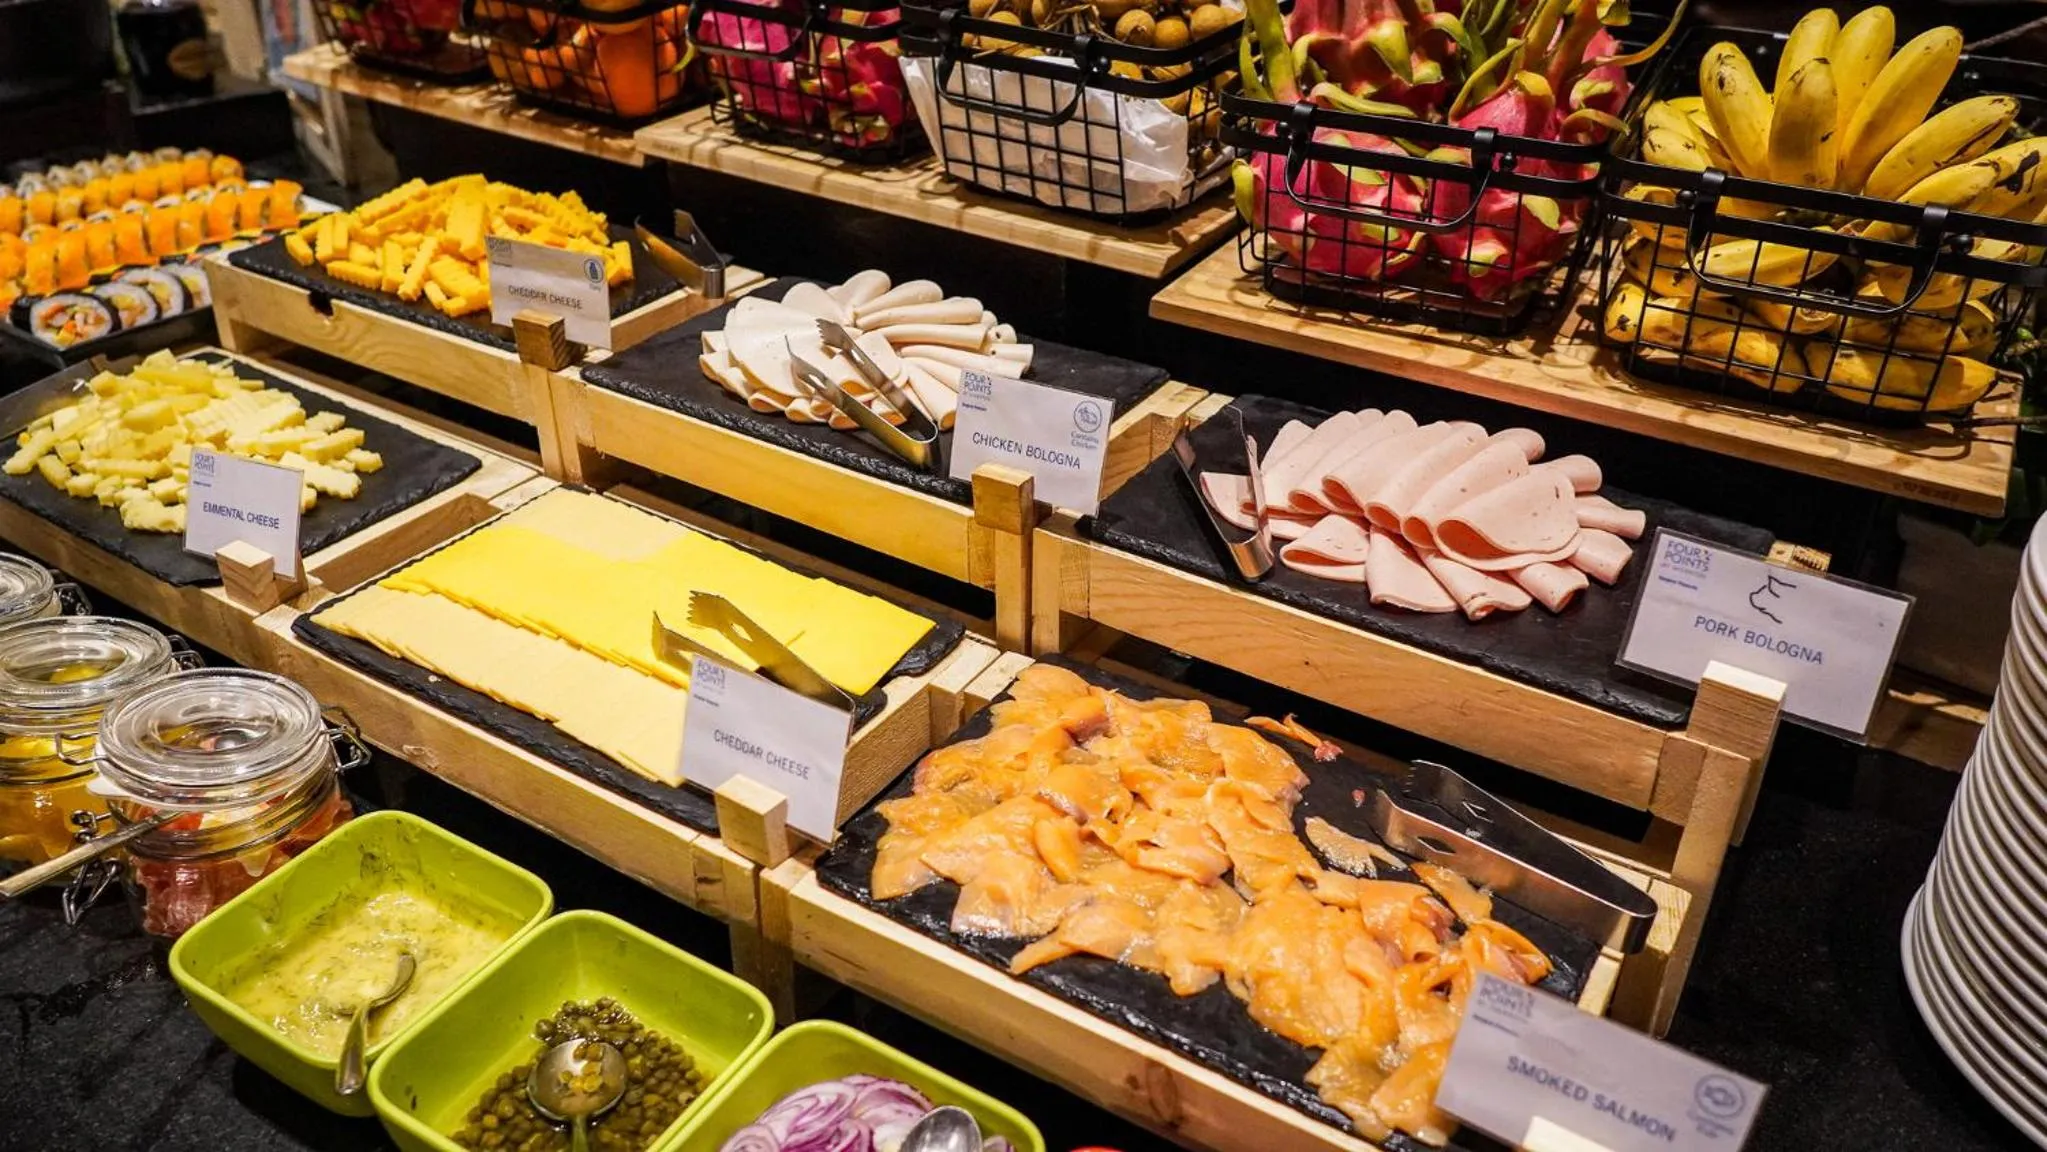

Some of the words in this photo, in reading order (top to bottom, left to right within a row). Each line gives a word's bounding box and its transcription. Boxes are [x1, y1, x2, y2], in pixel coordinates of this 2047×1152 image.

[549, 294, 582, 309] CHEESE
[972, 432, 1023, 455] CHICKEN
[1025, 445, 1081, 470] BOLOGNA
[203, 501, 245, 521] EMMENTAL
[246, 512, 280, 529] CHEESE
[1663, 550, 1710, 573] POINTS
[1666, 540, 1702, 559] FOUR
[1694, 615, 1738, 640] PORK
[1744, 631, 1824, 666] BOLOGNA
[714, 729, 764, 759] CHEDDAR
[766, 751, 810, 780] CHEESE
[1507, 1055, 1589, 1102] SMOKED
[1592, 1093, 1677, 1143] SALMON
